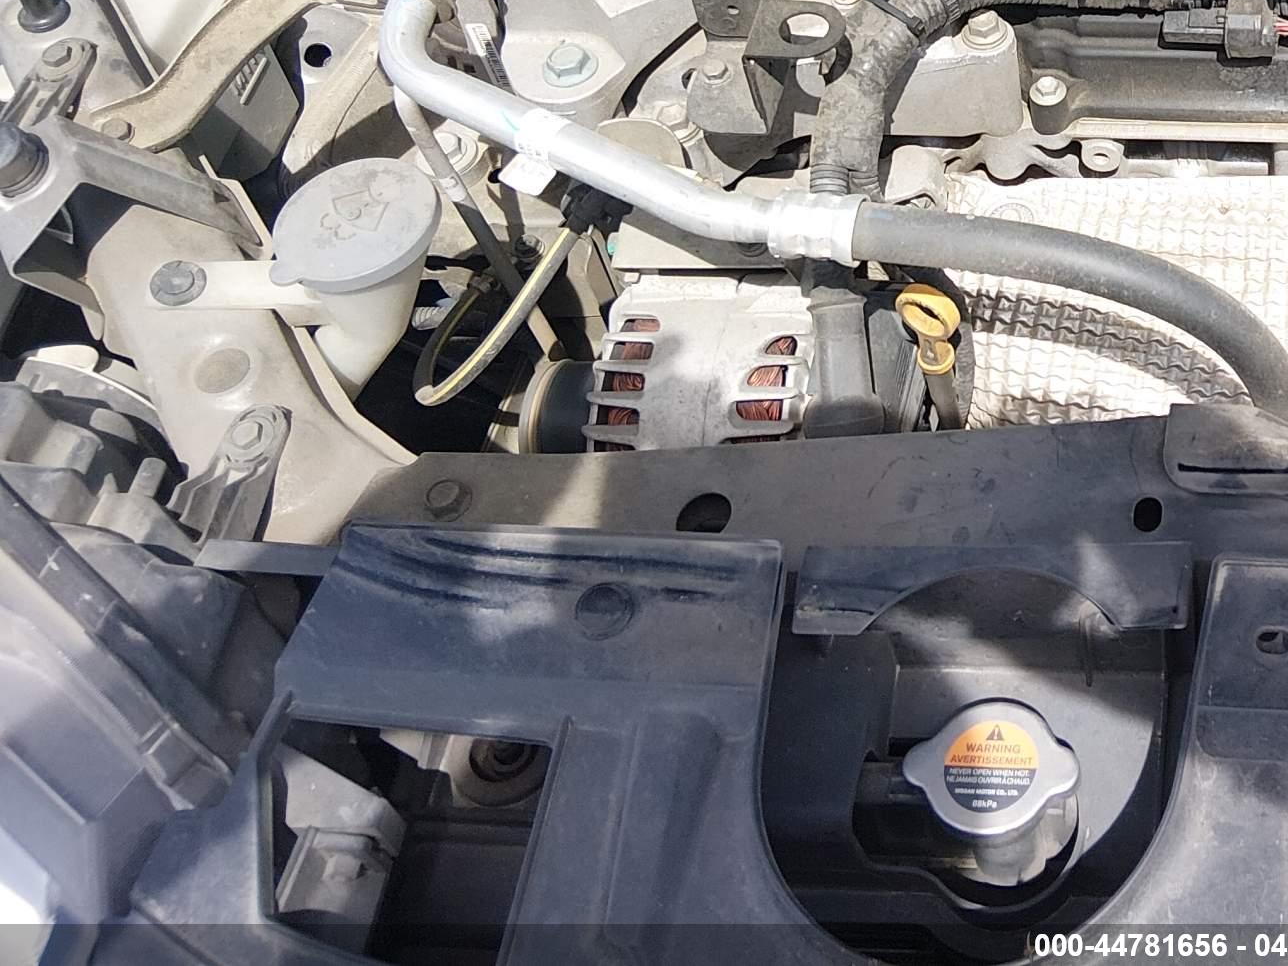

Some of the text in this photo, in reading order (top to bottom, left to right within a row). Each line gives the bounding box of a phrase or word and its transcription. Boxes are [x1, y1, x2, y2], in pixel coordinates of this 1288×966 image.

[966, 742, 1021, 754] WARNING
[950, 754, 1033, 765] AVERTISSEMENT
[972, 768, 992, 776] OPEN
